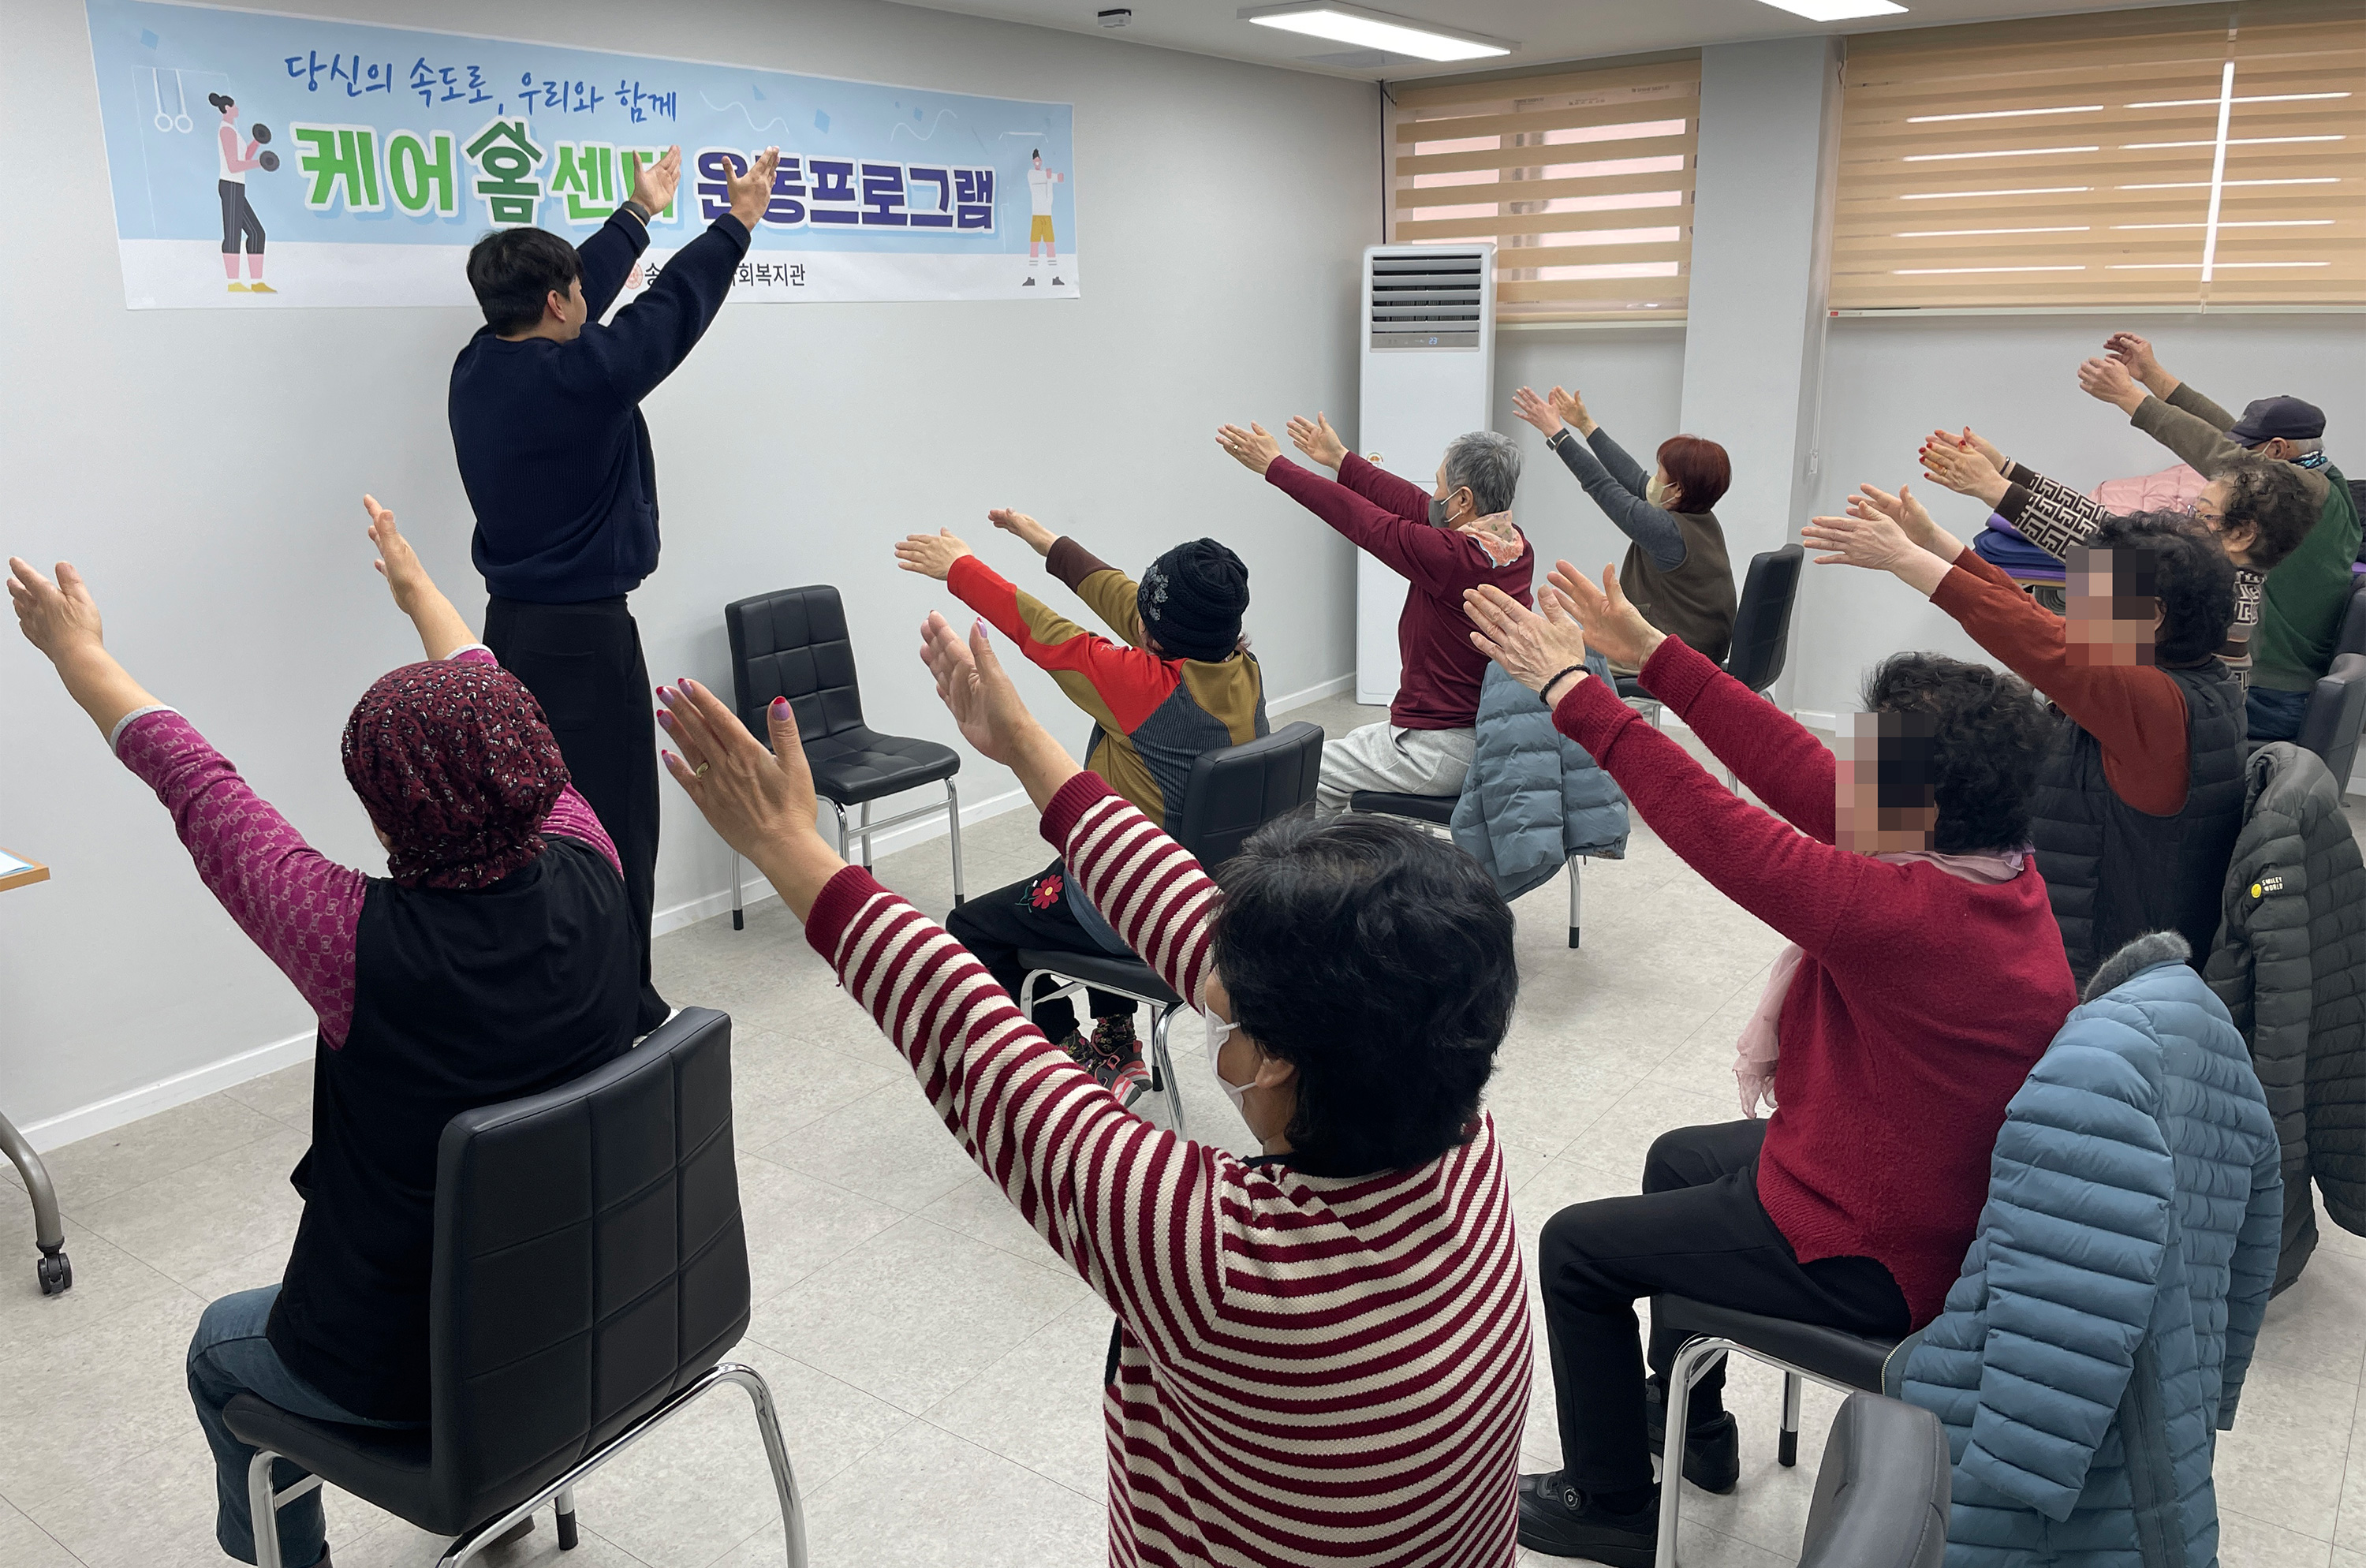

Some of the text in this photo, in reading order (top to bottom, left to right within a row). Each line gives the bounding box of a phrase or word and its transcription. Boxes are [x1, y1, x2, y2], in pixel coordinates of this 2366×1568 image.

[284, 49, 677, 124] 당신의 속도로, 우리와 함께
[697, 151, 994, 229] 운동프로그램
[1428, 337, 1438, 345] 23
[2262, 876, 2282, 886] SMILEY
[2263, 883, 2283, 891] WORLD
